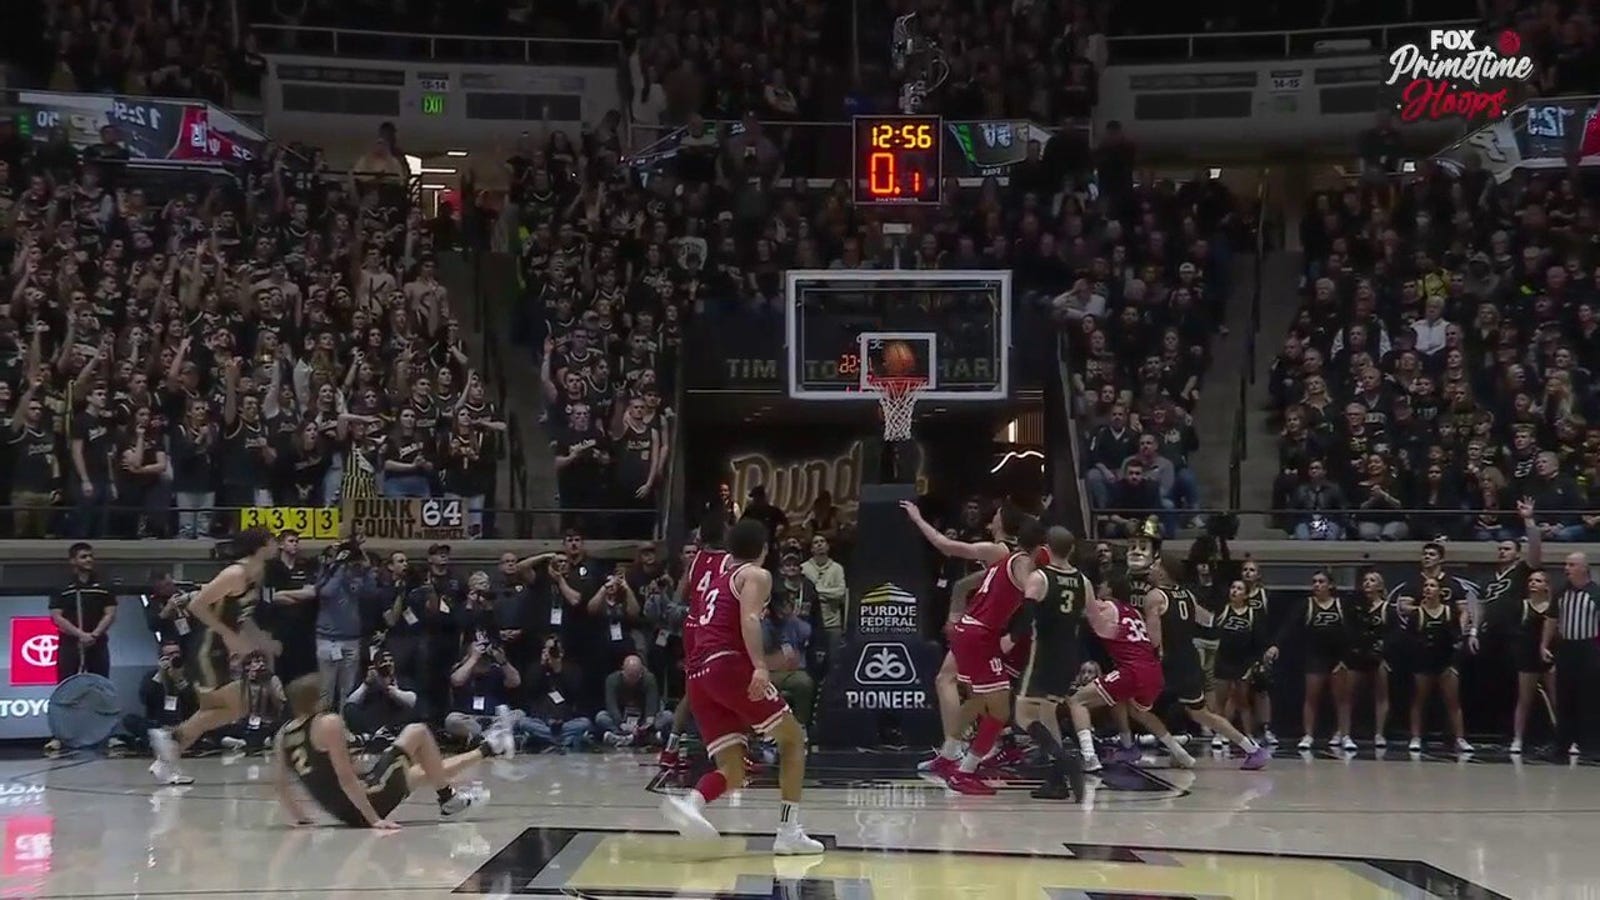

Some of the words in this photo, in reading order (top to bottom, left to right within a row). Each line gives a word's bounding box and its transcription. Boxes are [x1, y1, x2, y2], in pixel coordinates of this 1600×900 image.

[872, 125, 931, 148] 12:56
[871, 152, 919, 194] 0.1
[727, 359, 777, 379] TIM
[248, 510, 258, 528] 3
[272, 510, 284, 529] 3
[296, 510, 307, 529] 3
[321, 510, 332, 529] 3
[354, 499, 412, 518] DUNK
[422, 500, 461, 526] 64
[352, 518, 416, 538] COUNT
[697, 570, 711, 600] 4
[699, 588, 719, 625] 3
[860, 605, 917, 616] PURDUE
[1060, 590, 1074, 613] 3
[1178, 600, 1189, 621] 0
[860, 617, 917, 627] FEDERAL
[845, 691, 926, 709] PIONEER
